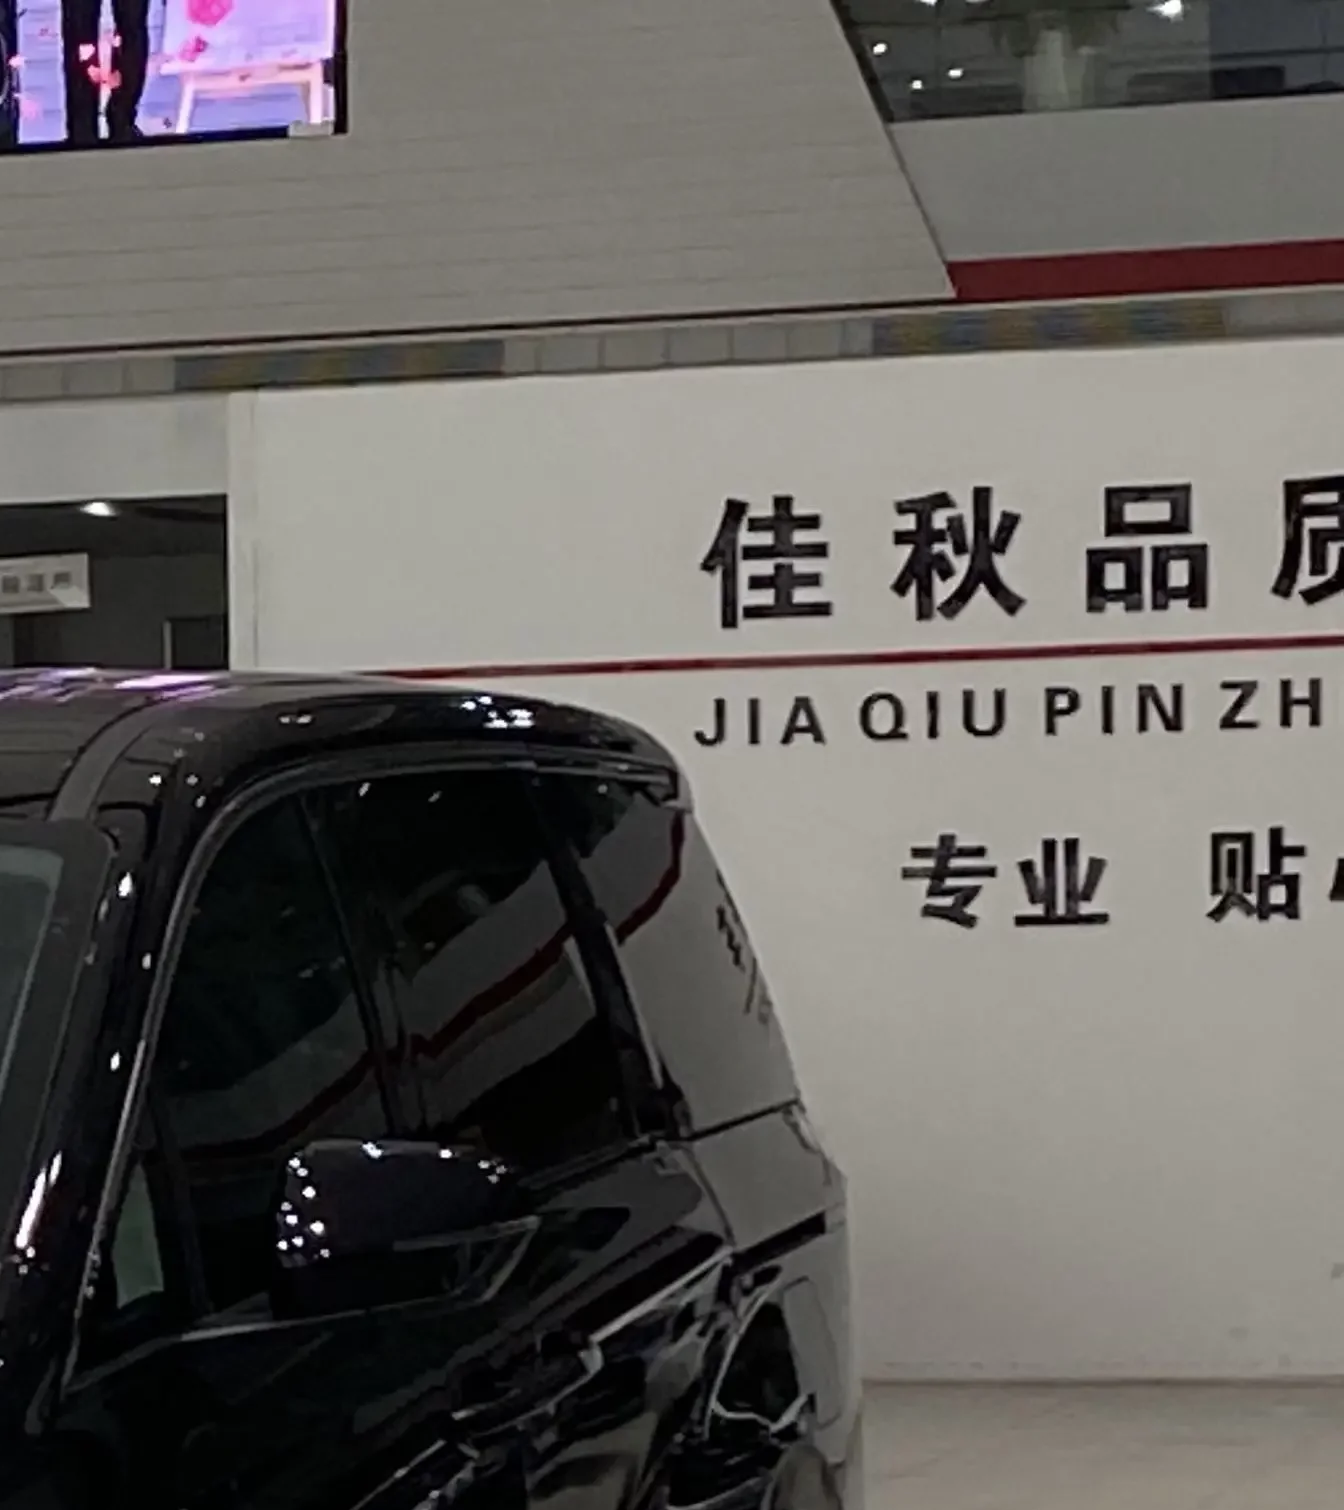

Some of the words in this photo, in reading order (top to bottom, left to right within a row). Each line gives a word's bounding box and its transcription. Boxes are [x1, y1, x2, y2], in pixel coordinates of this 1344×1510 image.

[694, 696, 825, 747] JIA
[859, 688, 1006, 741] QIU
[1044, 683, 1184, 736] PIN
[901, 834, 1110, 929] 专业
[1205, 826, 1344, 923] 贴
